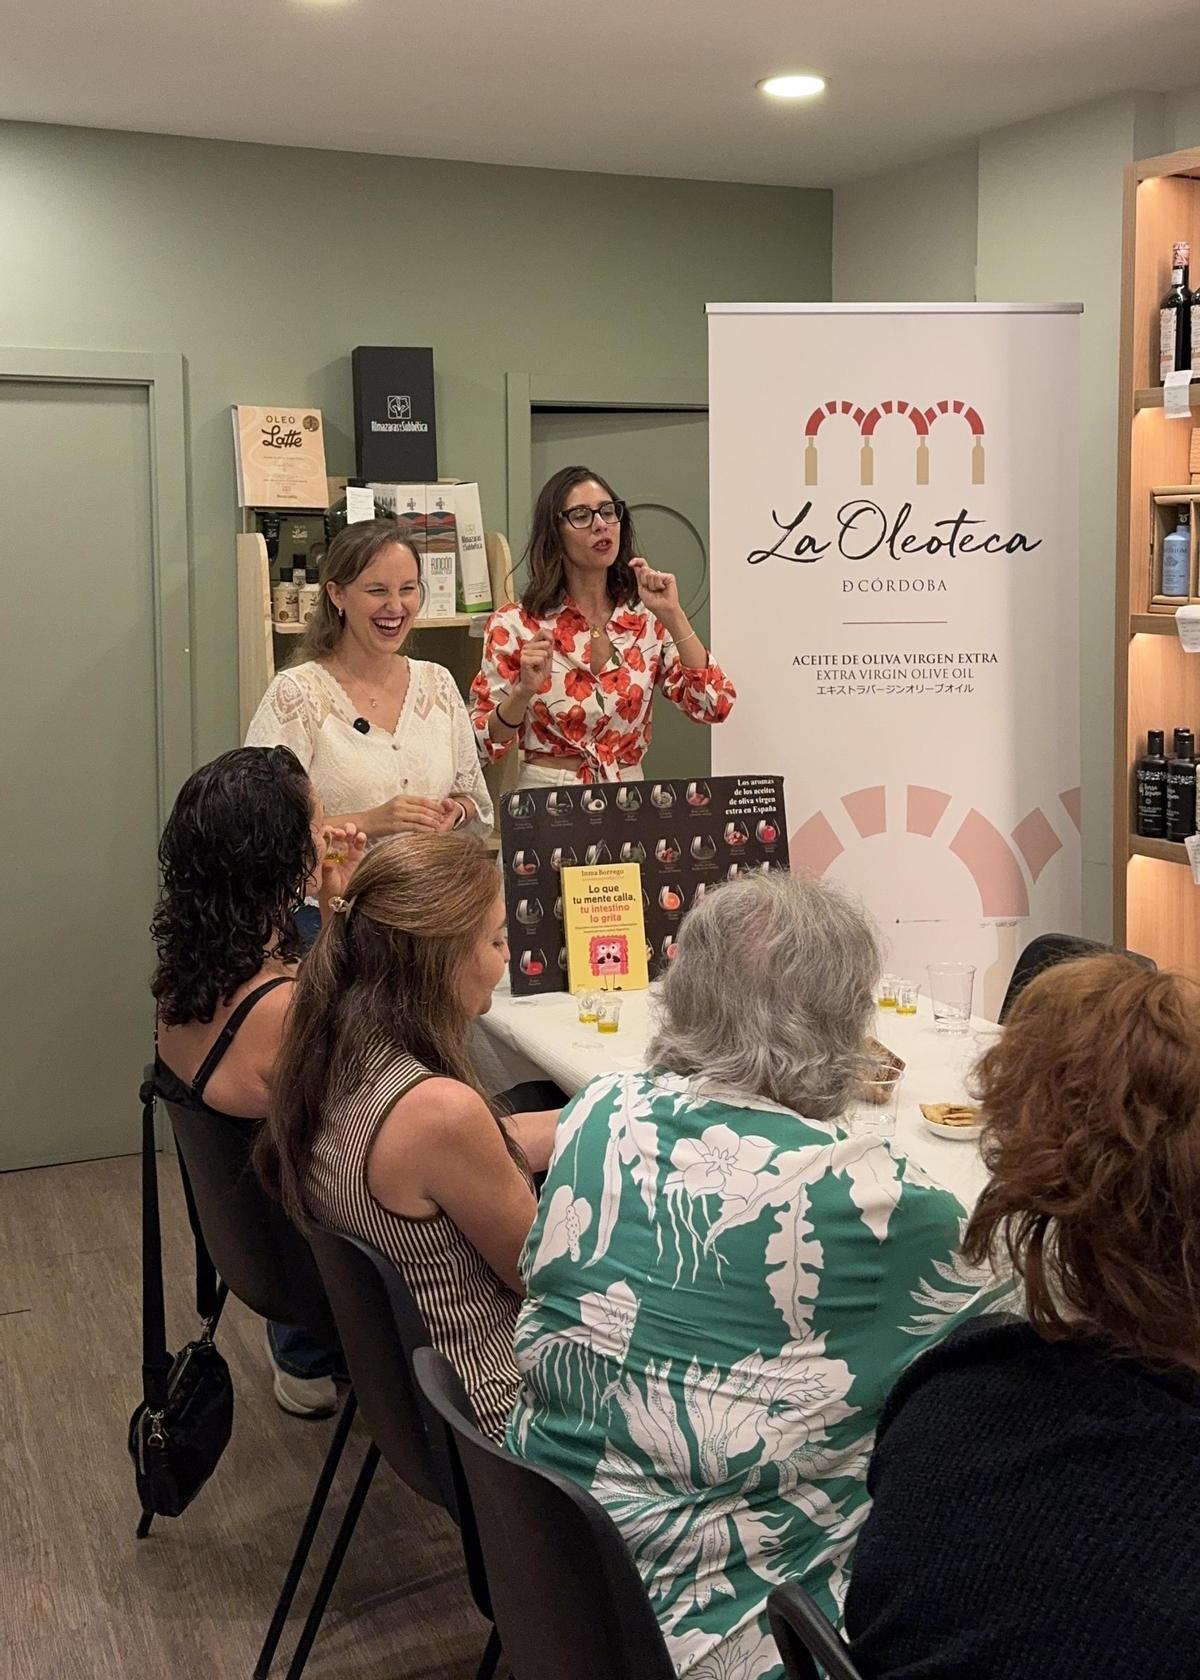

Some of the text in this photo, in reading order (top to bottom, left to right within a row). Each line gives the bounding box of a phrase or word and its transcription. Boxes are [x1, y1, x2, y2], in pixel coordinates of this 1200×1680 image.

[265, 415, 296, 425] OLEO
[261, 425, 303, 449] Latte
[747, 499, 1043, 565] La Oleoteca
[792, 652, 999, 666] ACEITE DE OLIVA VIRGEN EXTRA
[816, 667, 975, 681] EXTRA VIRGIN OLIVE OIL
[737, 778, 775, 786] Los aromas
[734, 786, 775, 796] de los aceites
[729, 796, 776, 806] de oliva virgen
[752, 805, 777, 815] España
[581, 869, 624, 877] Inma Borrego
[588, 885, 620, 894] Lo que
[573, 892, 636, 905] tu mente calla,
[580, 903, 630, 914] tu intestino
[590, 914, 622, 924] lo grita
